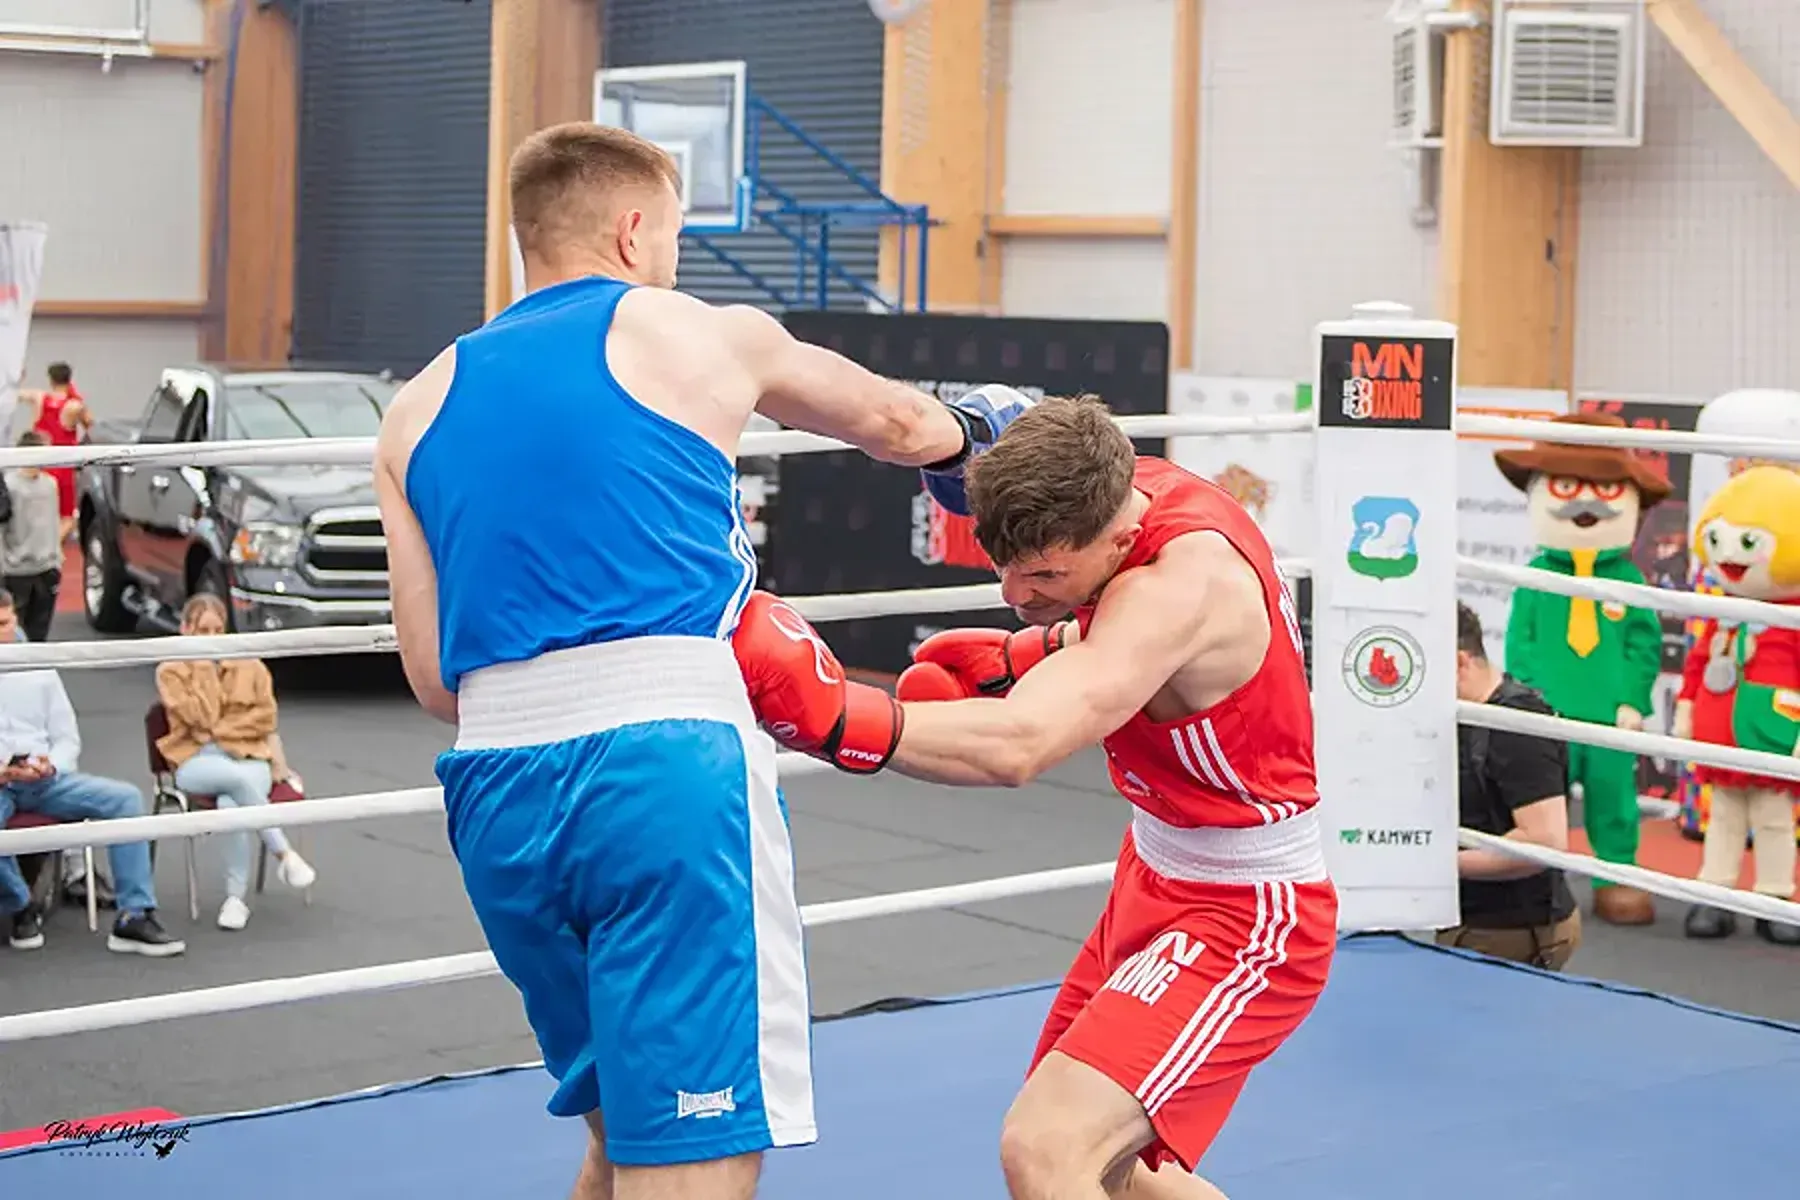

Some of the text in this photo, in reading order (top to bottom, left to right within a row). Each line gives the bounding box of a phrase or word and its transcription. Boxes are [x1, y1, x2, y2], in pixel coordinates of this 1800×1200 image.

[1351, 342, 1424, 379] MN
[1342, 377, 1422, 420] BOXING
[840, 748, 883, 762] STING
[1367, 829, 1433, 846] KAMWET
